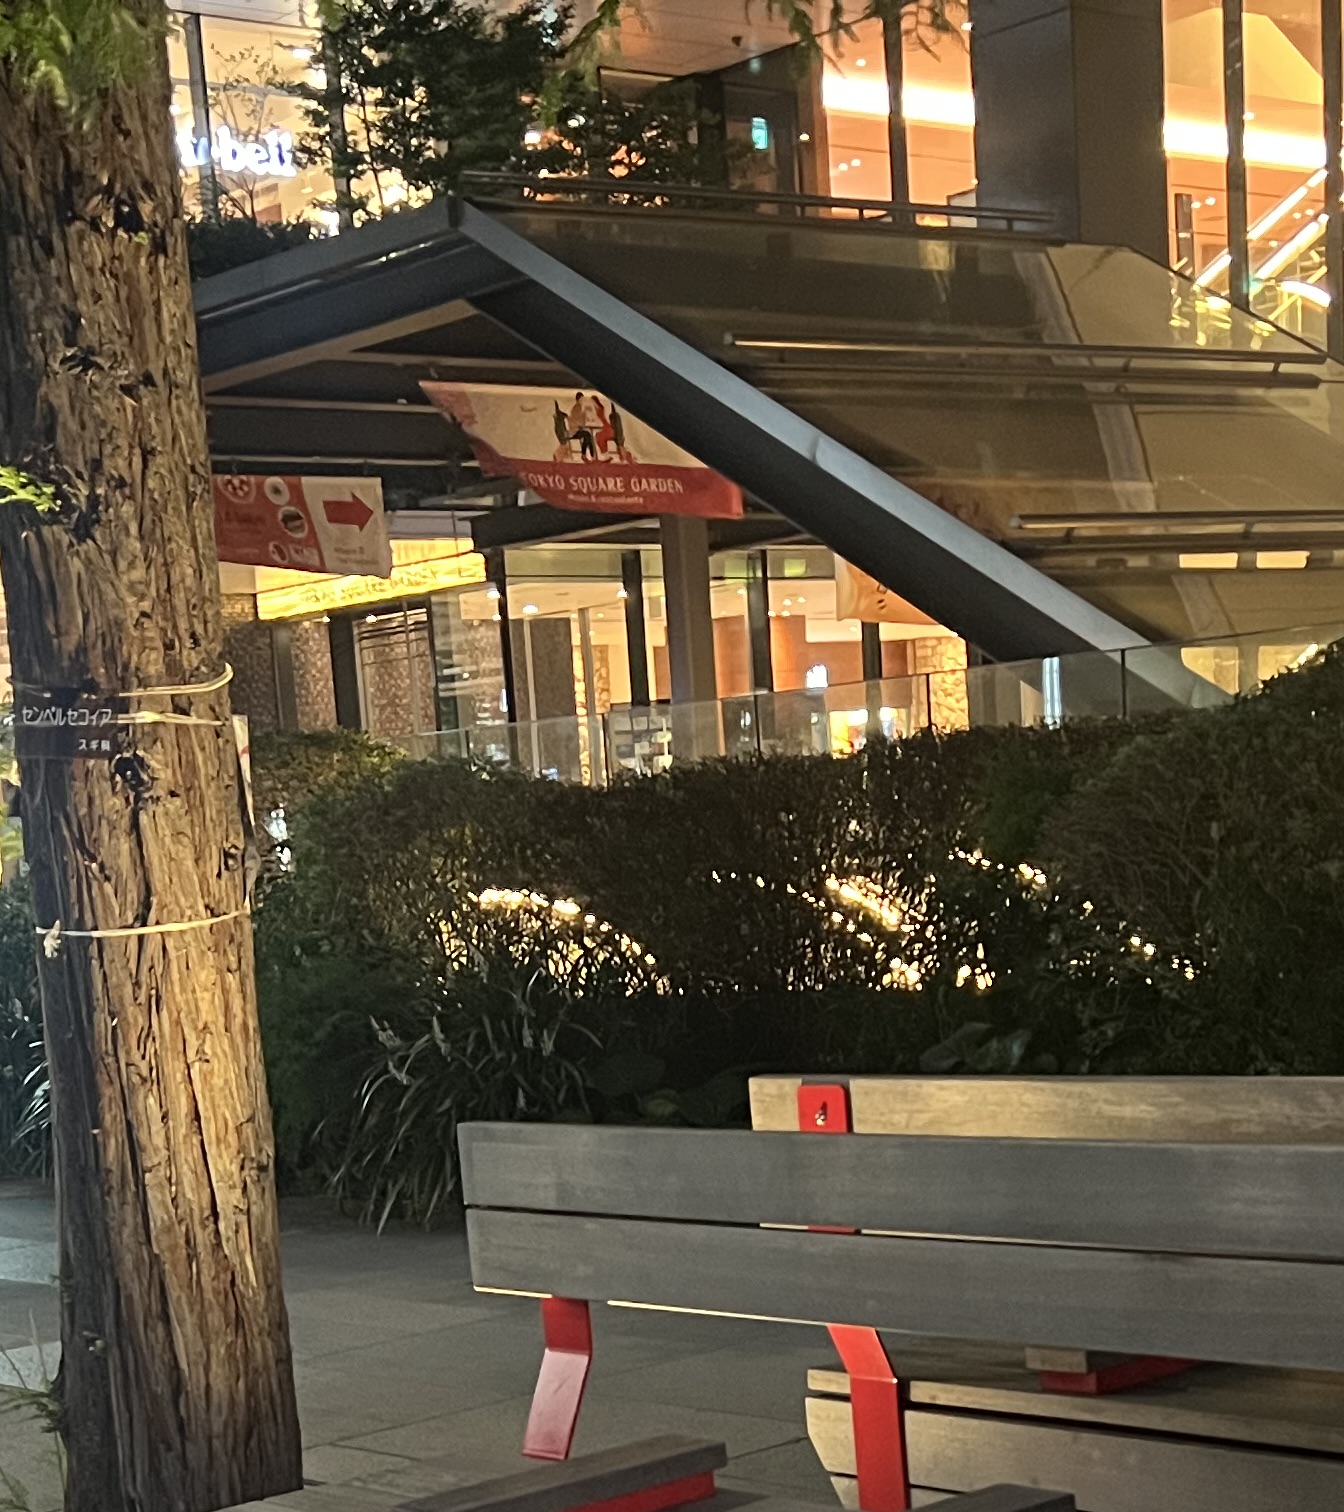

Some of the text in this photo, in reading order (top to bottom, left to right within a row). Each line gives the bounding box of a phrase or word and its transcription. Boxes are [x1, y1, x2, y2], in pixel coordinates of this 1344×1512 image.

[571, 476, 625, 494] SQUARE
[631, 477, 684, 494] GARDEN
[22, 706, 112, 727] センペルセコイア
